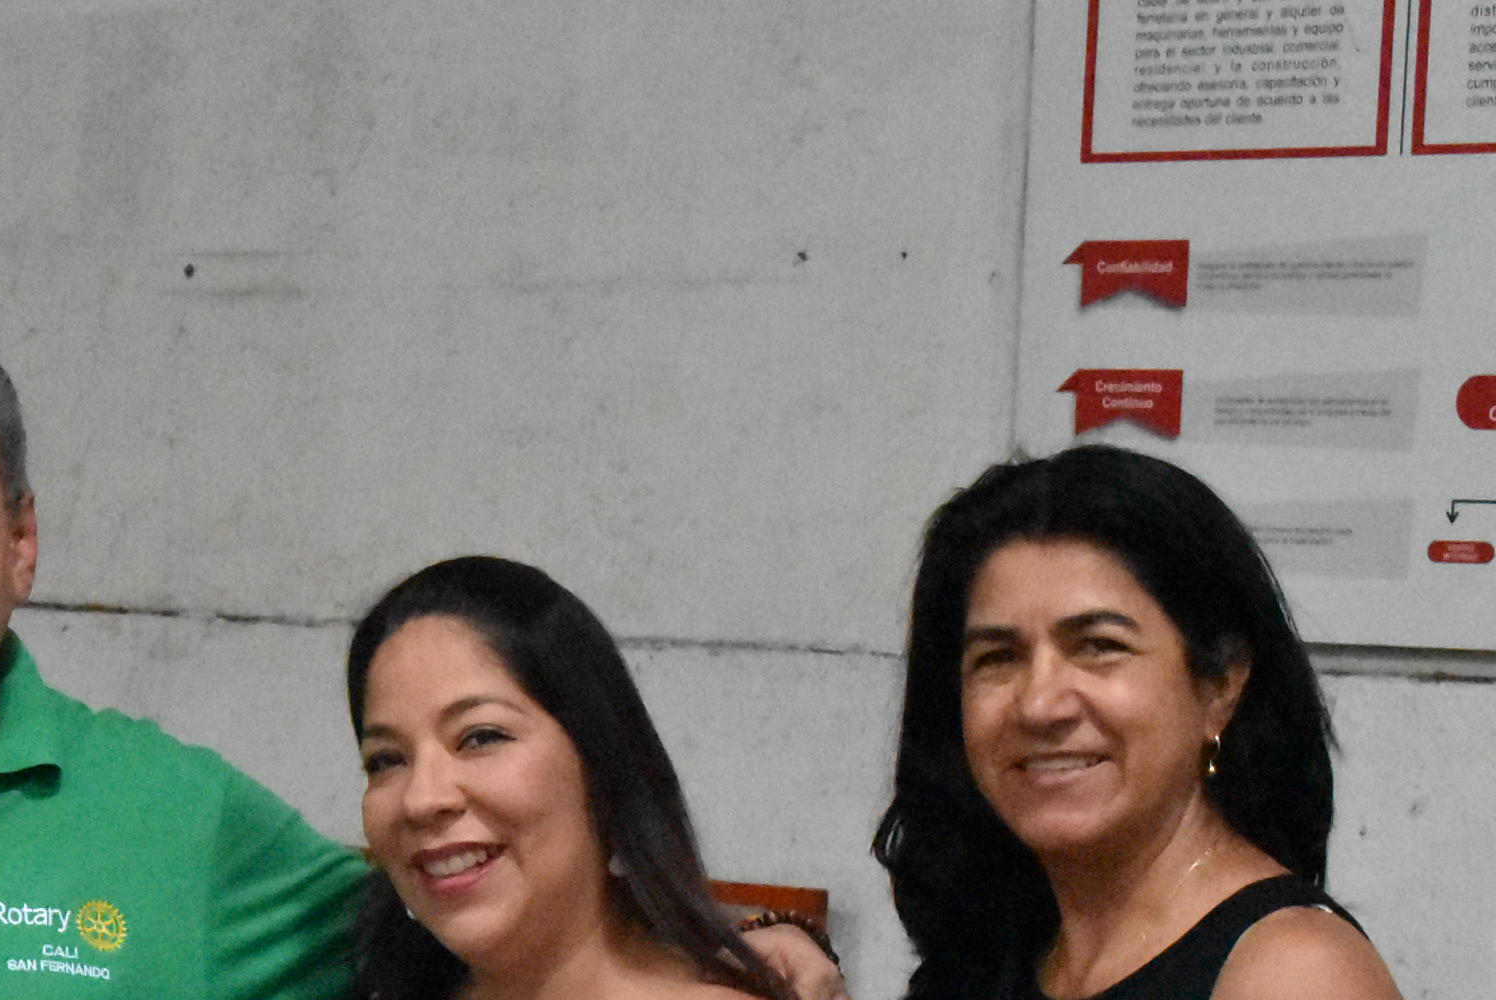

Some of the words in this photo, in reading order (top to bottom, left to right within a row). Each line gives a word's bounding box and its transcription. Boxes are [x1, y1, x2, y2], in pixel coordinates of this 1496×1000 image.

[1304, 22, 1344, 37] equipo
[1181, 44, 1216, 57] sector
[1214, 63, 1221, 75] y
[1230, 60, 1242, 72] la
[1333, 77, 1340, 89] y
[1236, 94, 1251, 107] de
[1256, 93, 1303, 107] acuerdo
[1096, 259, 1174, 275] Confiabilidad
[1094, 379, 1163, 394] Crecimiento
[41, 943, 80, 960] CALI
[6, 958, 38, 972] SAN
[40, 959, 111, 980] FERNANDO
